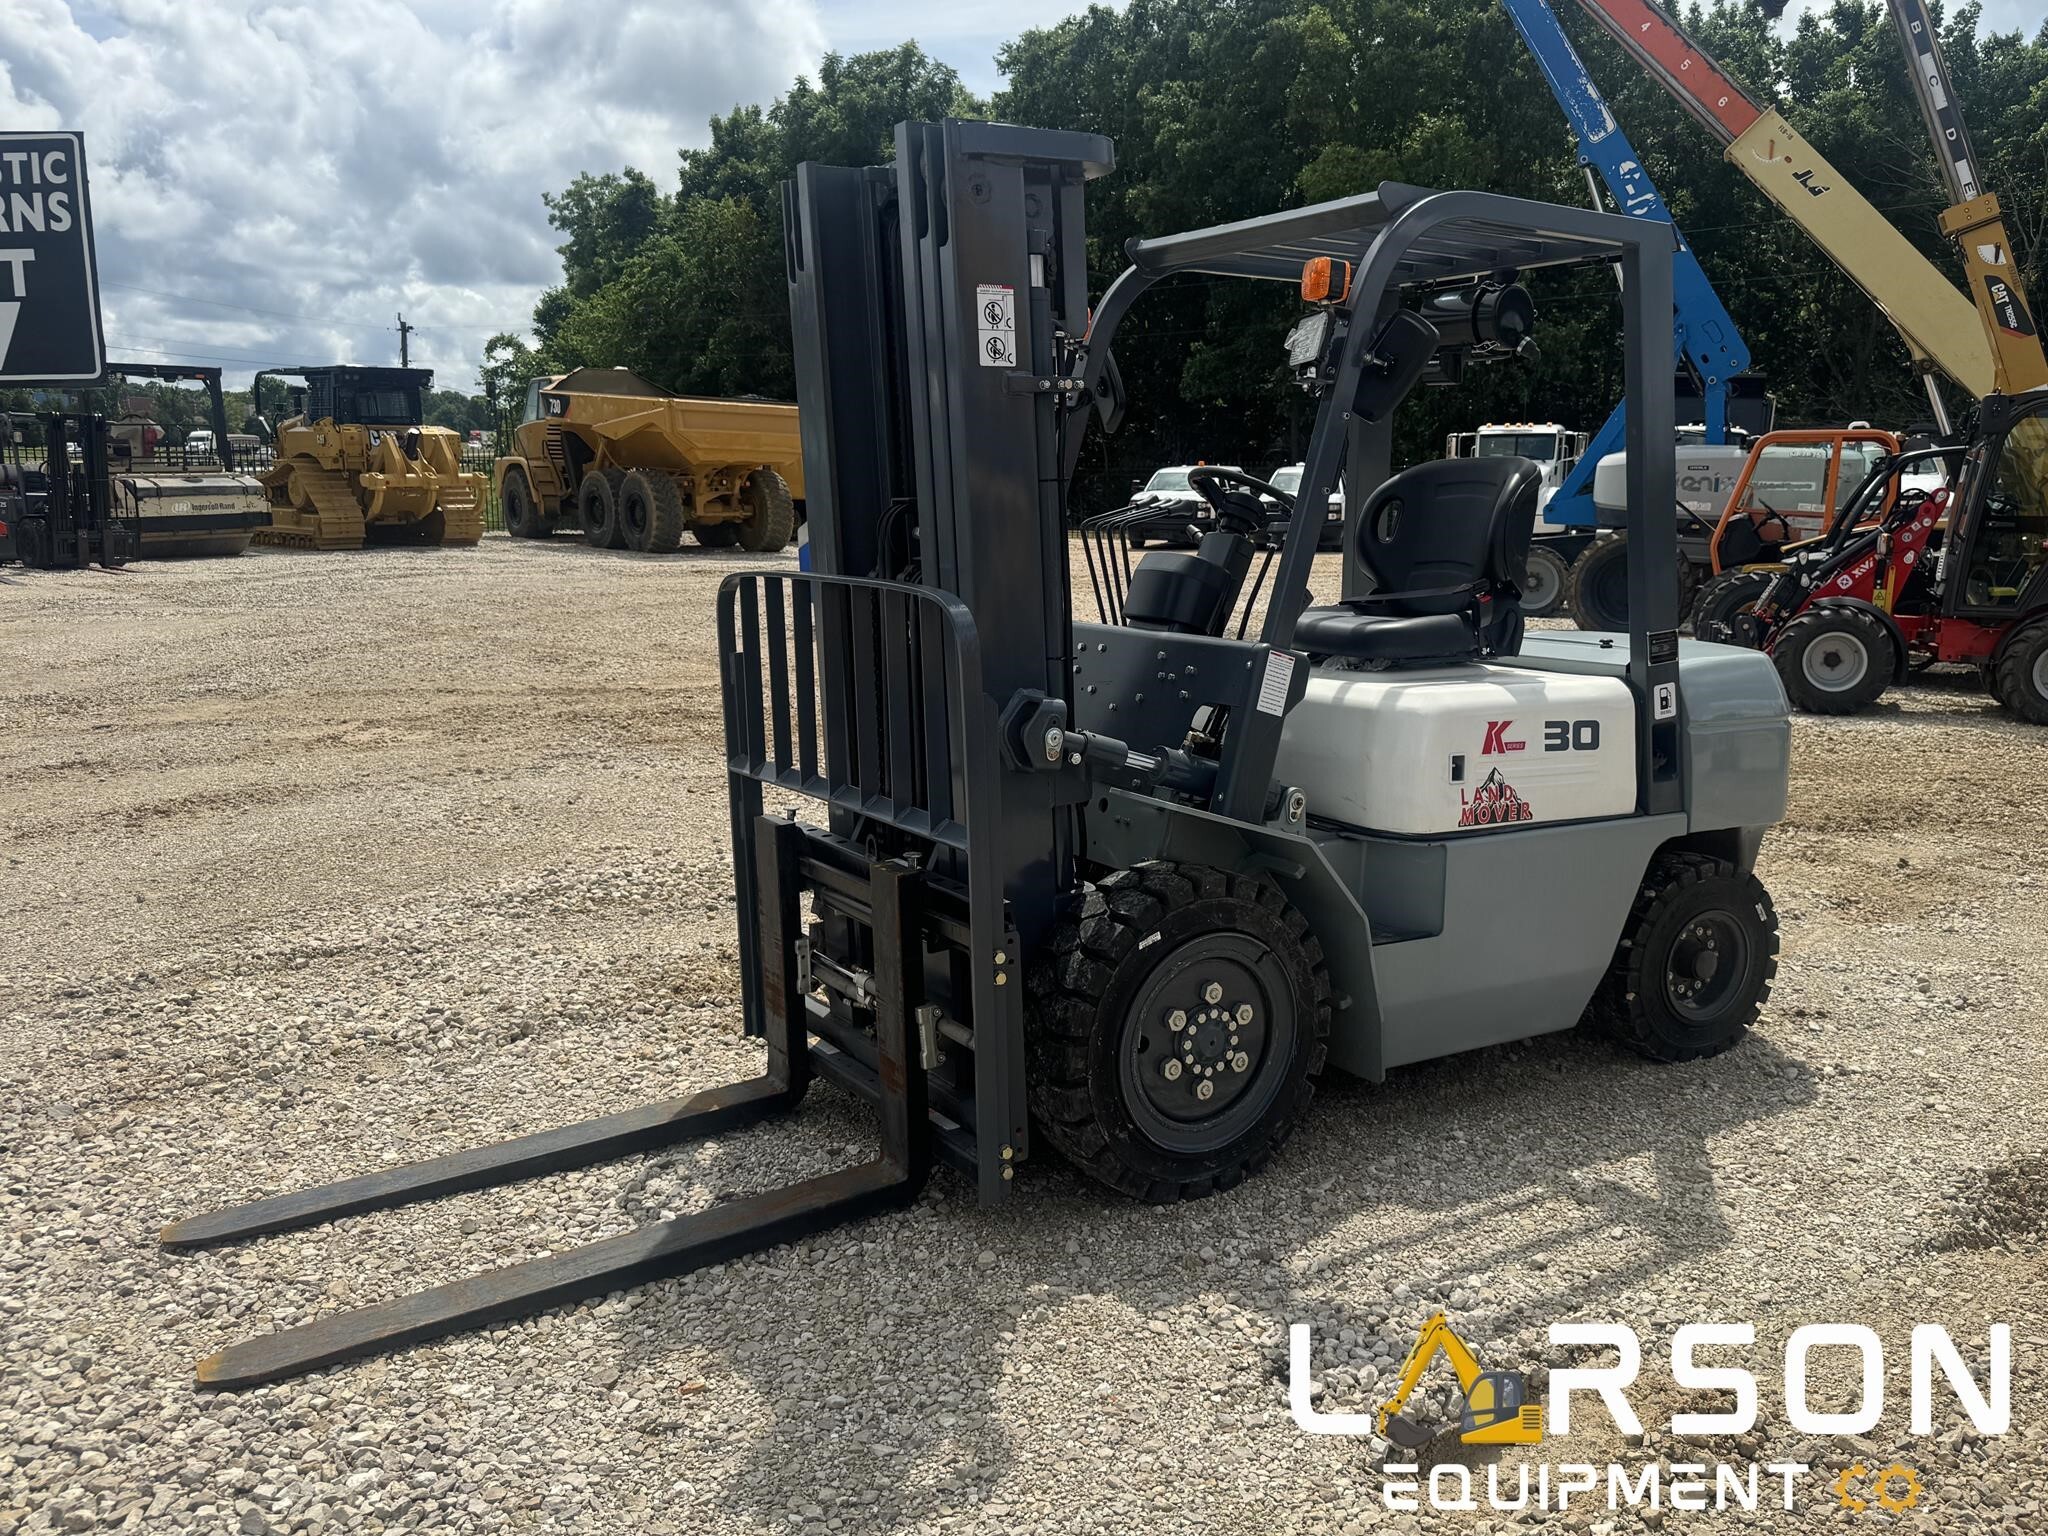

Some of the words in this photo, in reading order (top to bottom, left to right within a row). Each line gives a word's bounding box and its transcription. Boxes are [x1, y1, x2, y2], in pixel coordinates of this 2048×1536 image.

[1641, 22, 1651, 32] 4
[1910, 20, 1922, 34] B
[1680, 59, 1692, 70] 5
[1929, 75, 1939, 88] C
[1718, 97, 1729, 107] 6
[1945, 128, 1957, 141] D
[0, 151, 68, 184] TIC
[1792, 168, 1831, 197] JLG
[1963, 181, 1976, 195] E
[1991, 283, 2010, 305] CAT
[549, 398, 561, 414] 730
[1482, 720, 1513, 754] K
[1544, 720, 1600, 751] 30
[1460, 784, 1513, 805] LAND
[1459, 801, 1532, 827] MOVER
